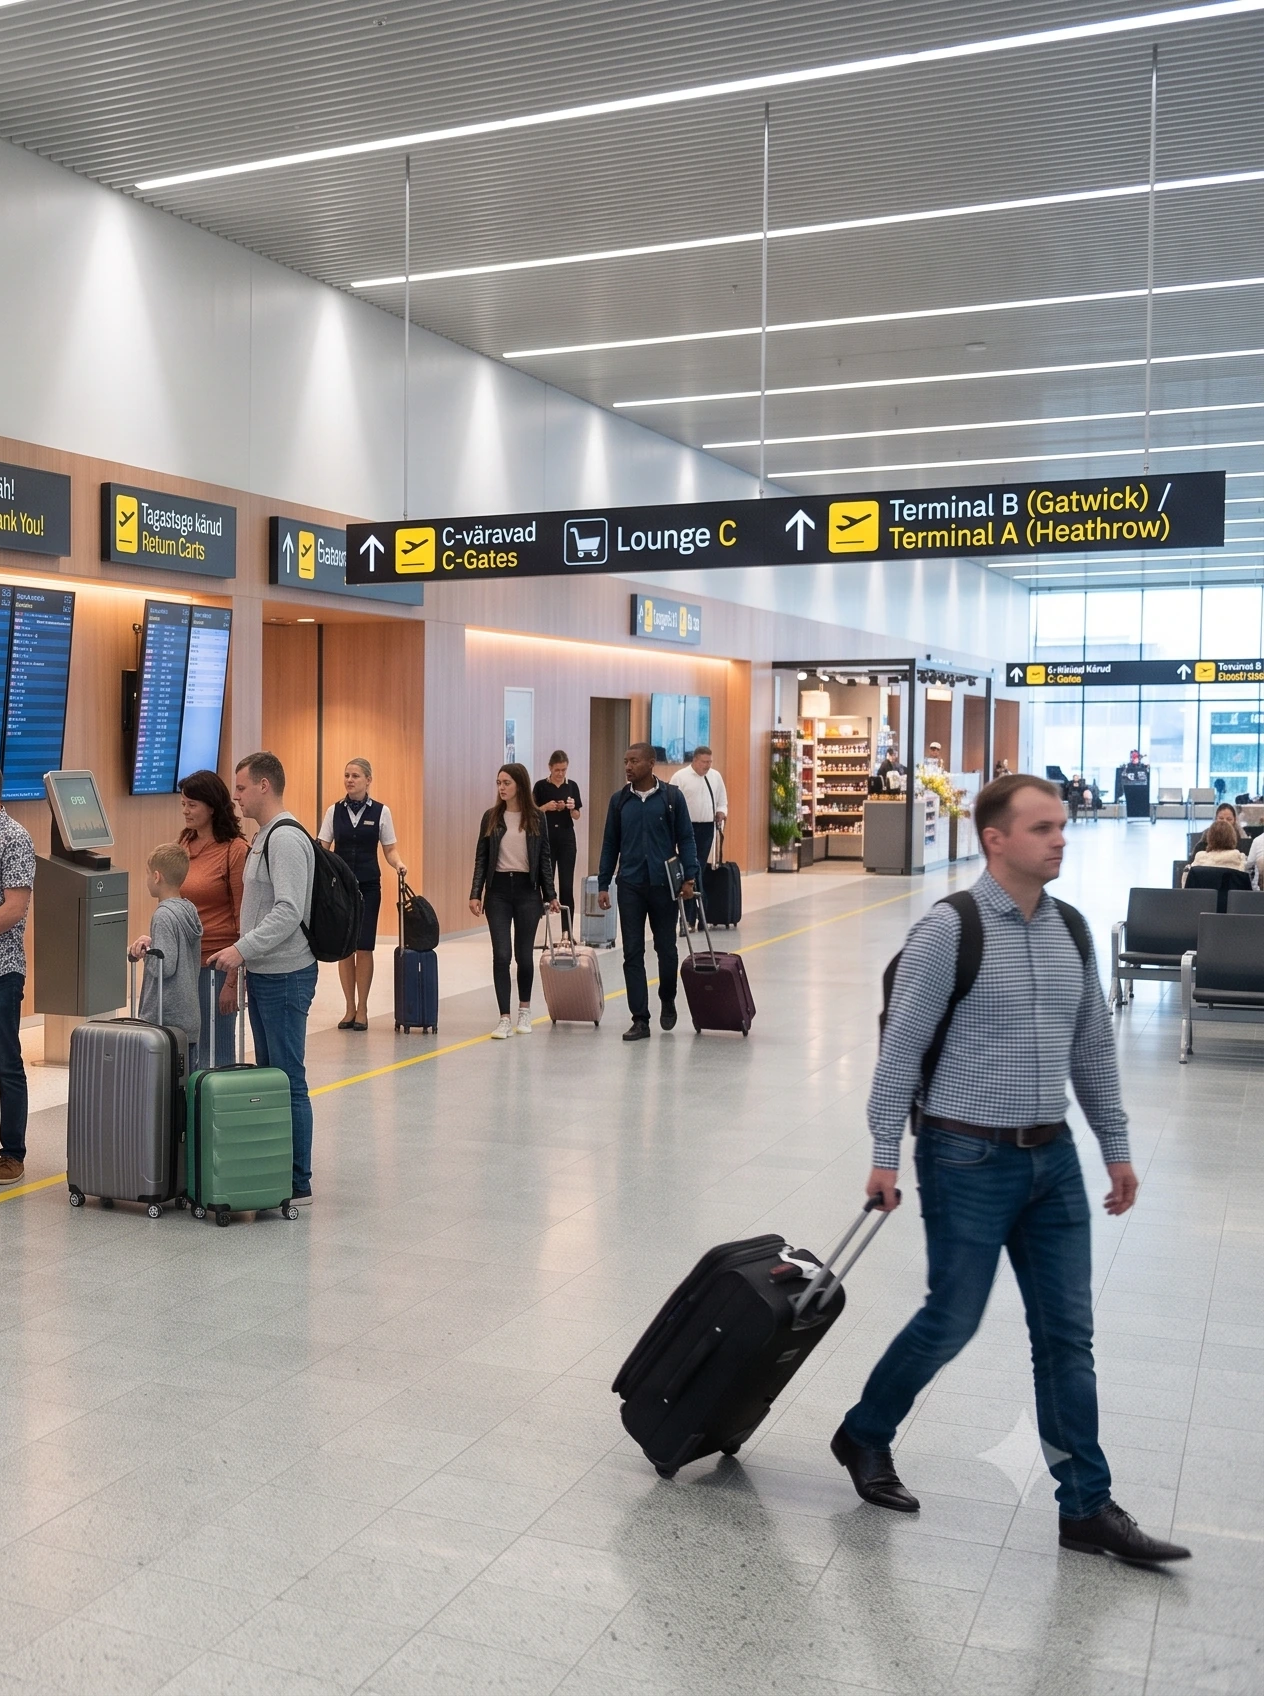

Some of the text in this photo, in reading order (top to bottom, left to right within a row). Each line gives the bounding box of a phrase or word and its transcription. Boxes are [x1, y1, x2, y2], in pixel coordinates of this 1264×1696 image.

[889, 482, 1172, 522] Terminal B (Gatwick) /
[19, 511, 44, 536] You!
[442, 520, 536, 546] C-väravad
[617, 519, 737, 555] Lounge C
[889, 512, 1170, 550] Terminal A (Heathrow)
[142, 531, 205, 561] Return Carts
[442, 549, 518, 570] C-Gates
